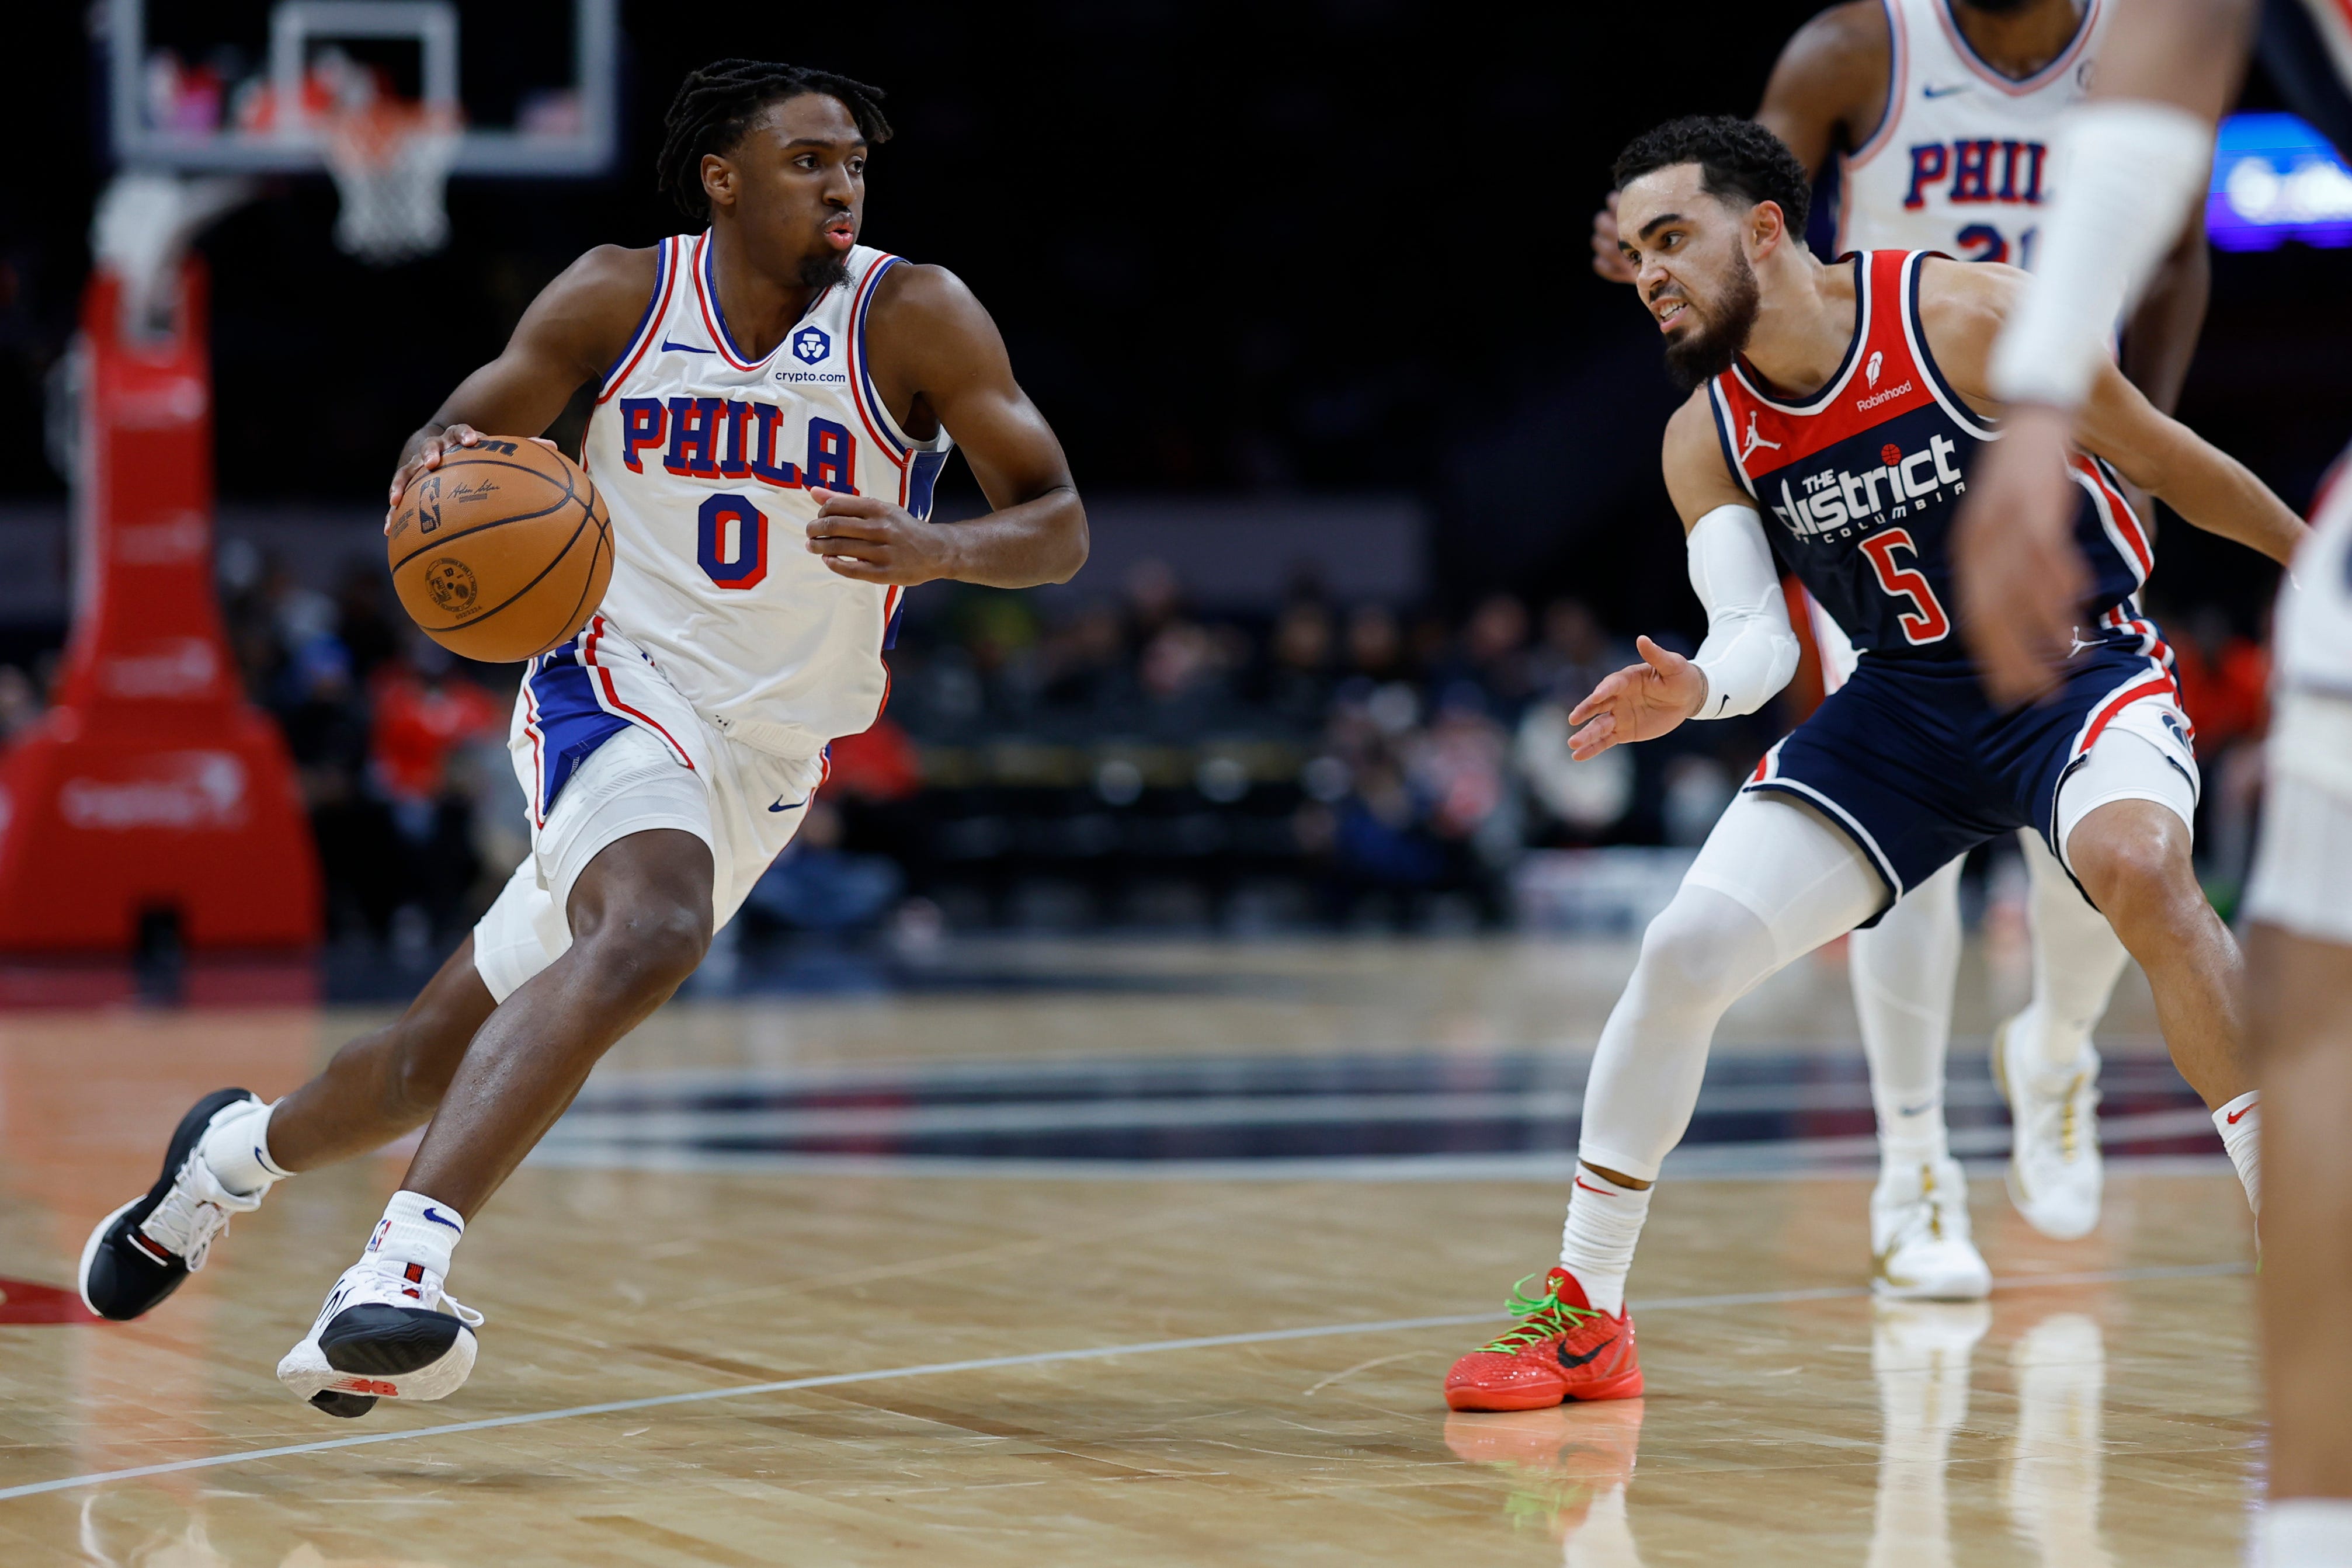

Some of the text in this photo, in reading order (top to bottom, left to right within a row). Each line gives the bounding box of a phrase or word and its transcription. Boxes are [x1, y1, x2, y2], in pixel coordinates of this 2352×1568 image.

[775, 371, 846, 383] crypto.com
[1856, 380, 1912, 412] Robinhood
[619, 397, 860, 496] PHILA
[1771, 433, 1962, 536] district
[1802, 468, 1837, 495] THE
[697, 493, 768, 590] 0
[1823, 481, 1967, 544] COLUMBIA
[1858, 527, 1951, 646] 5
